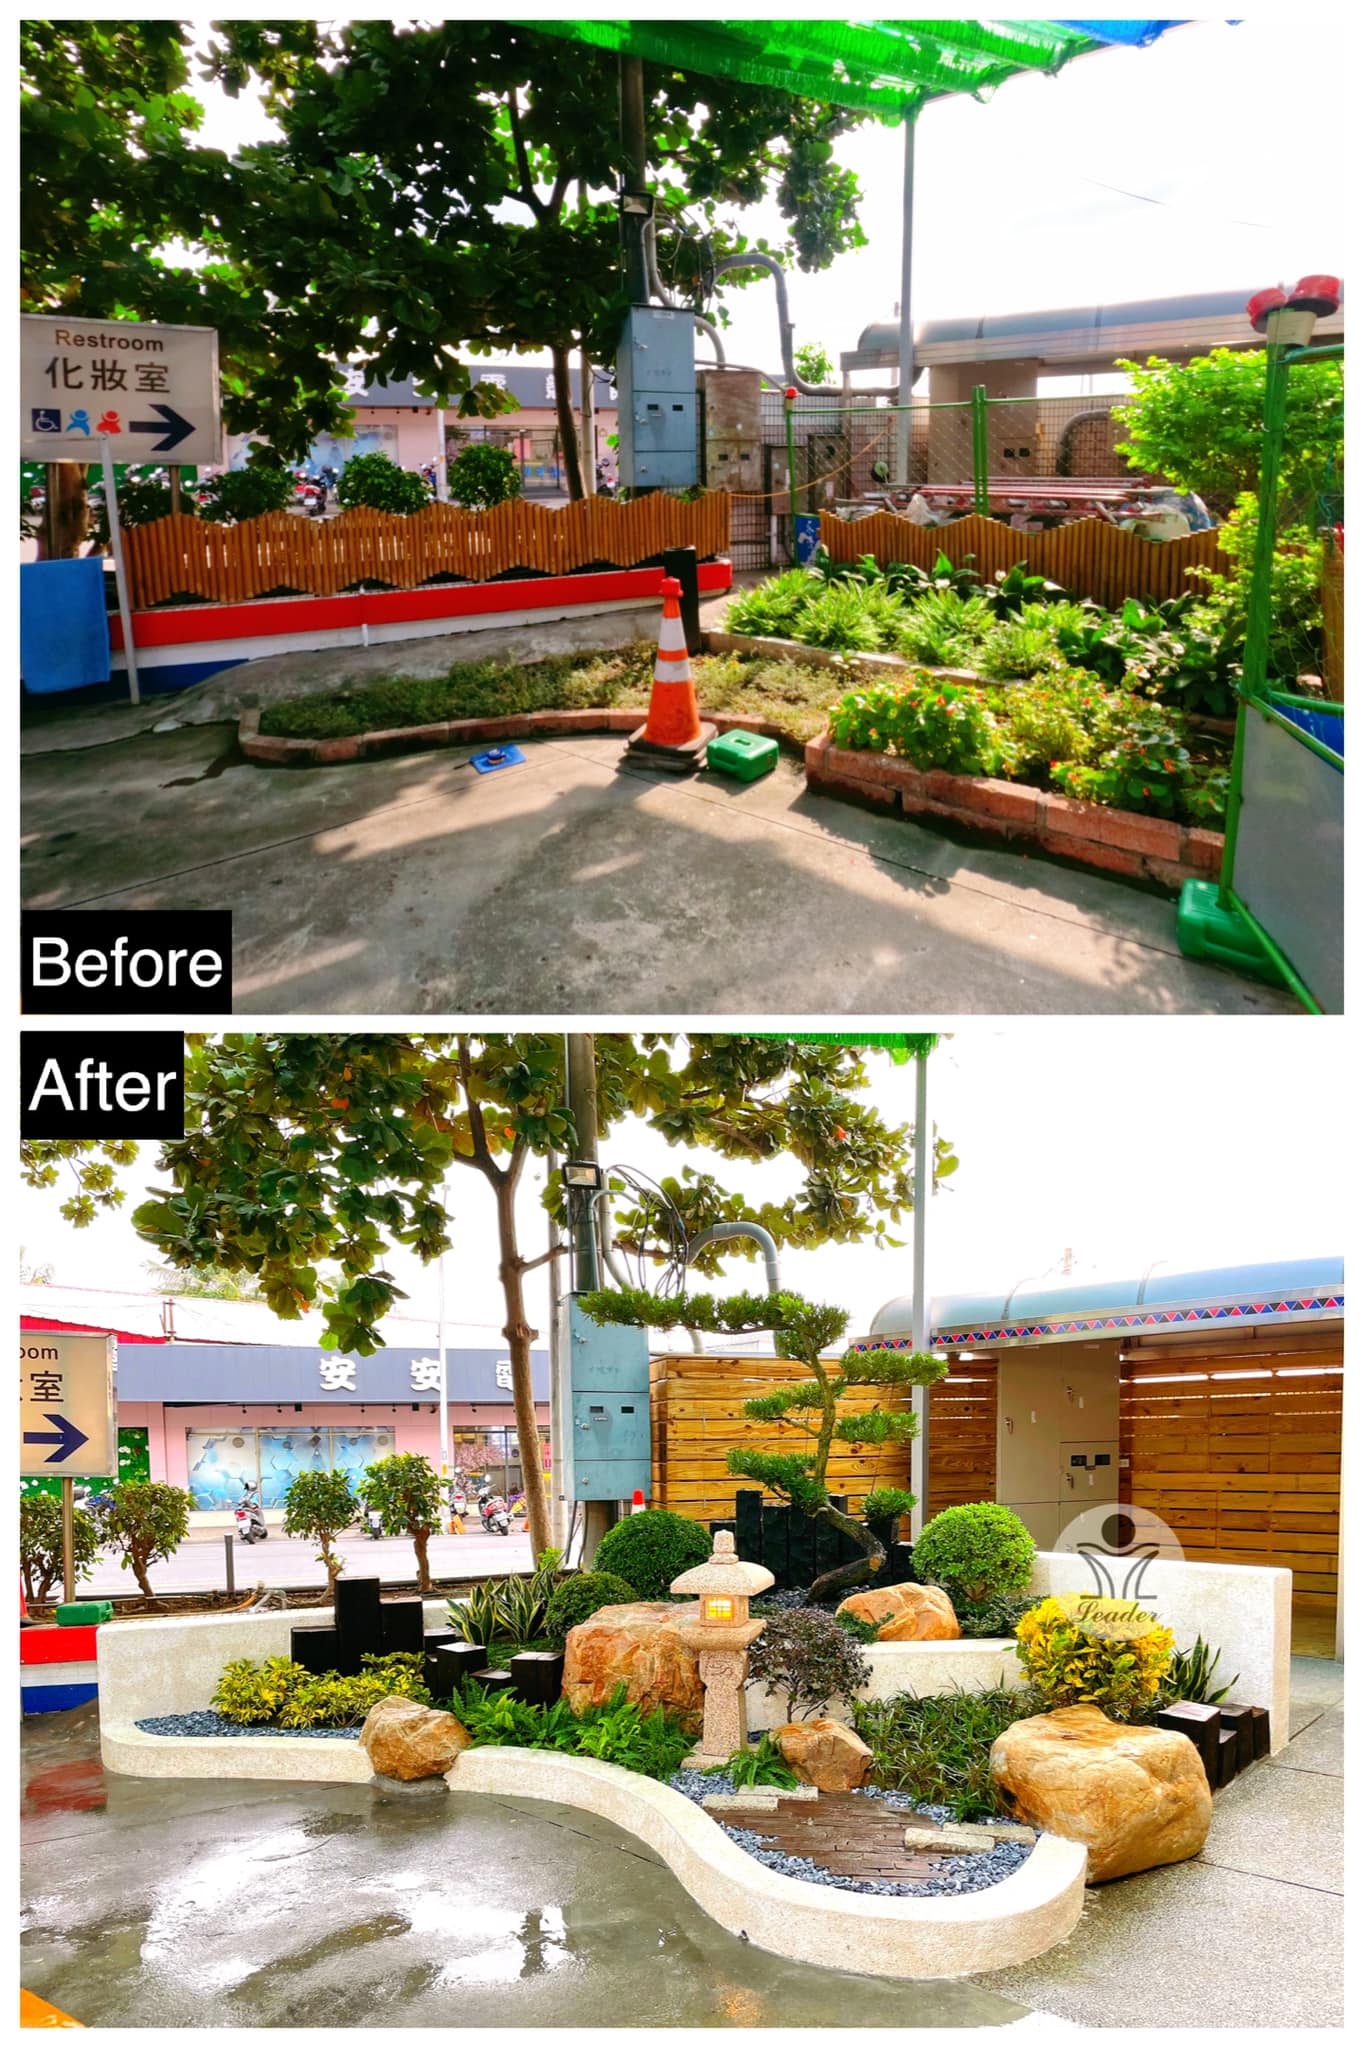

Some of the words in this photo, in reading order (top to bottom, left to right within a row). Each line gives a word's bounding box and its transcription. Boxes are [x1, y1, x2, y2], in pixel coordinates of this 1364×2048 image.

[55, 329, 164, 352] Restroom
[45, 356, 170, 394] 化妝室
[20, 1370, 64, 1402] 室
